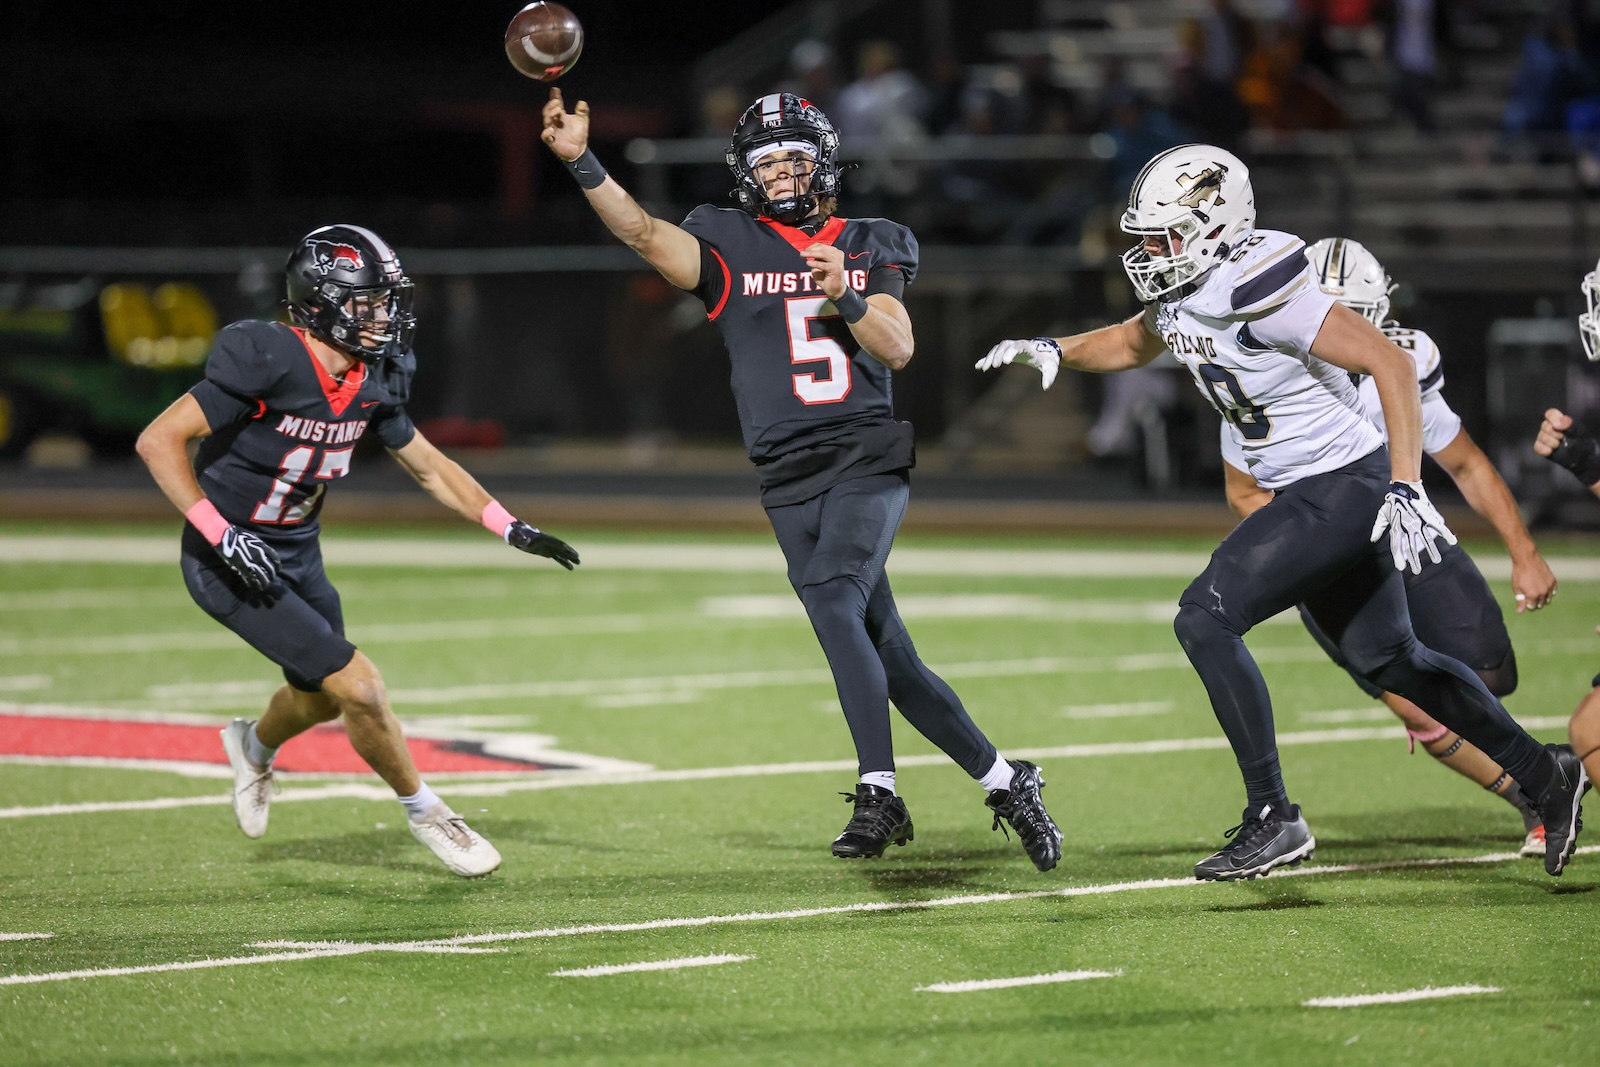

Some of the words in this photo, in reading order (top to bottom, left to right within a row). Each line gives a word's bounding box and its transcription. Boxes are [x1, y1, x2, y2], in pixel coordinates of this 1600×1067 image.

[742, 269, 868, 297] MUSTG
[784, 295, 852, 406] 5
[275, 413, 369, 444] MUSTANG
[250, 443, 355, 524] 17
